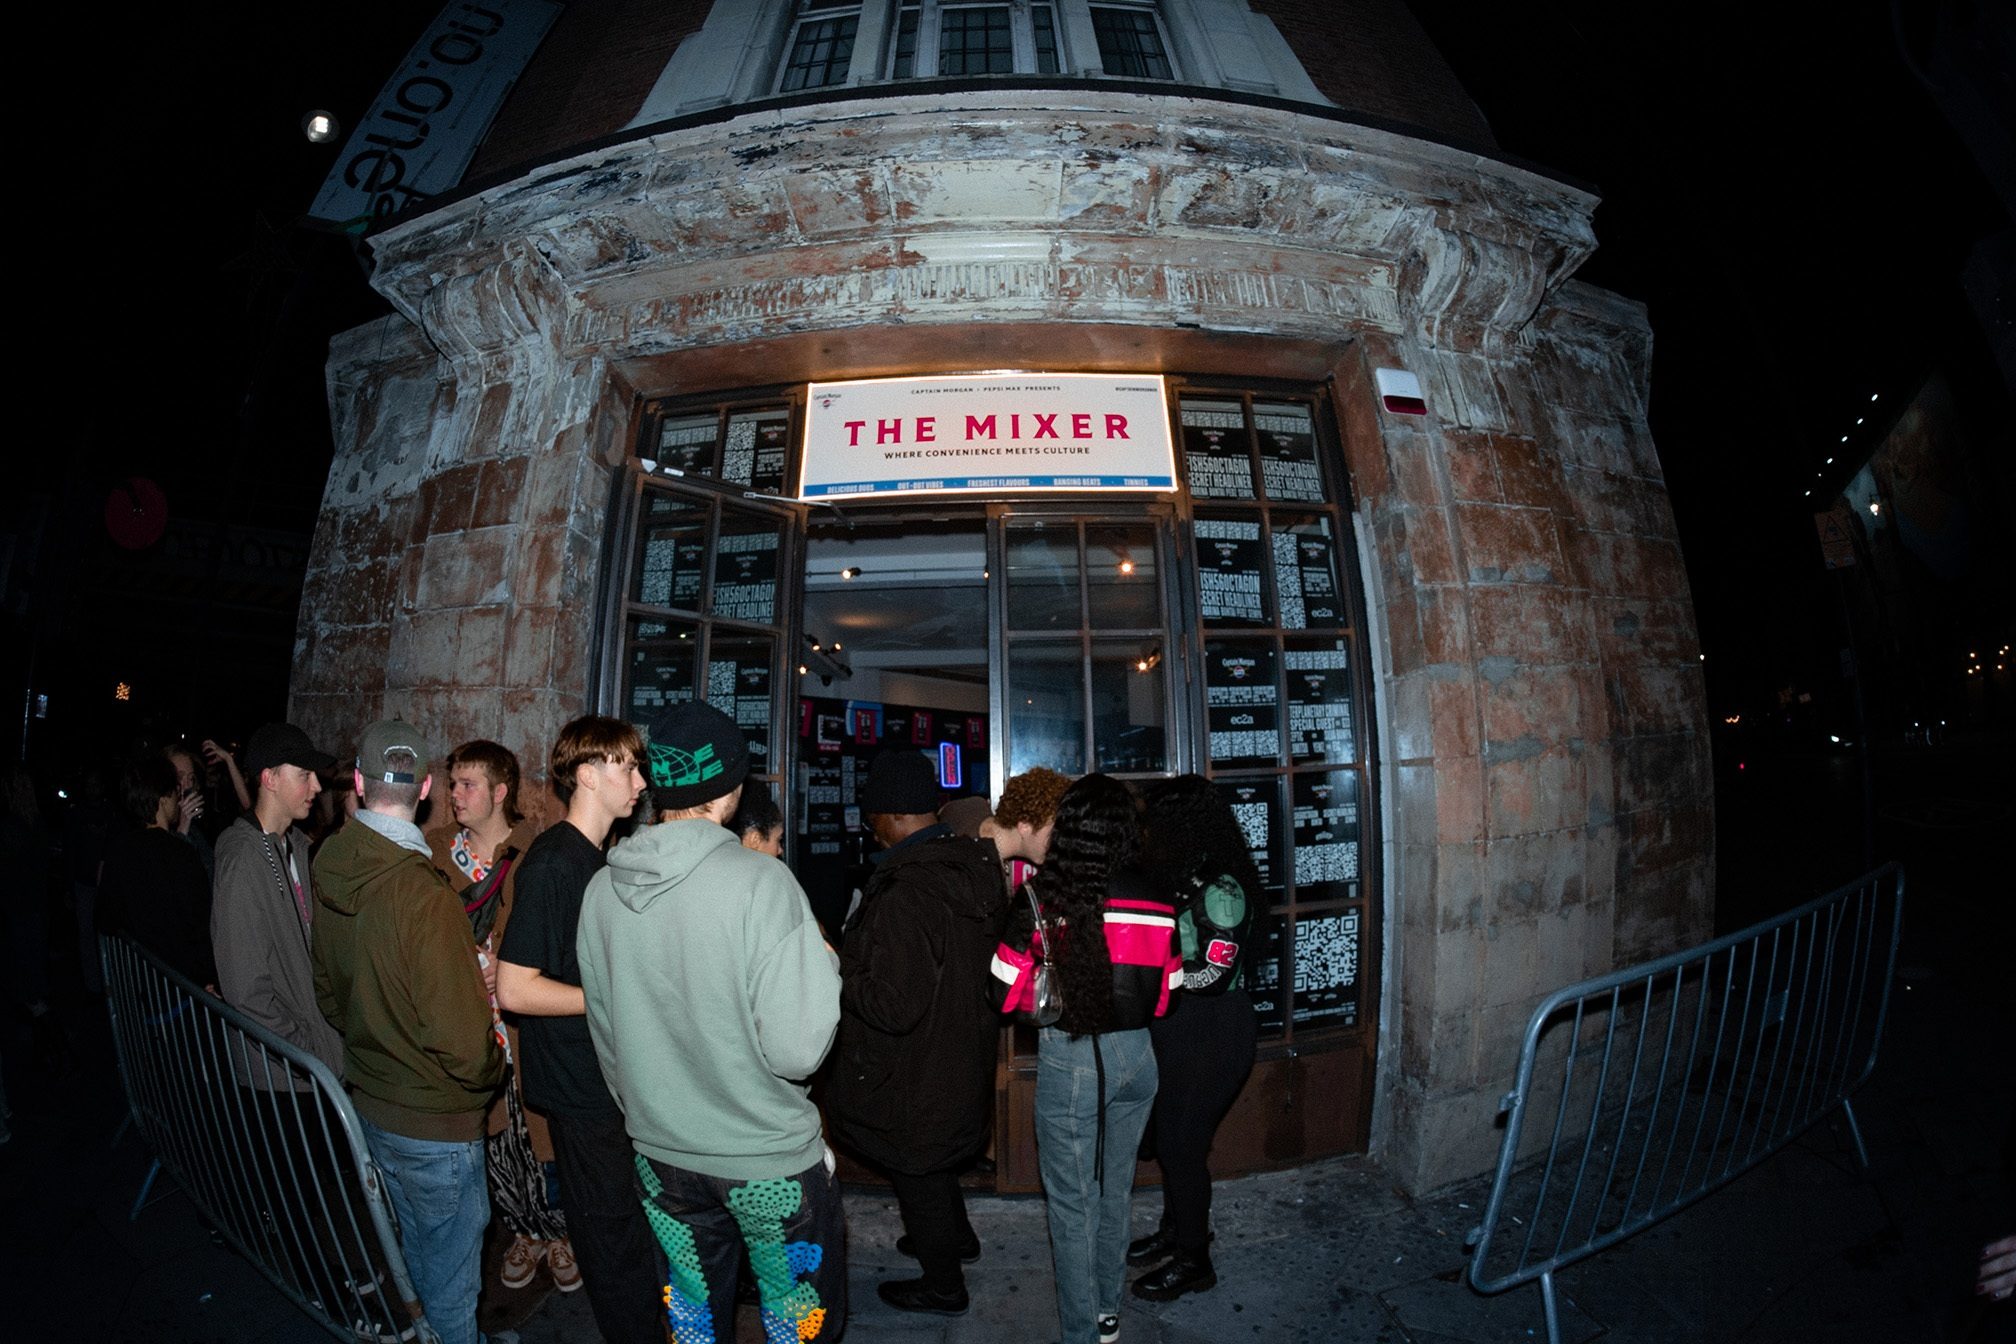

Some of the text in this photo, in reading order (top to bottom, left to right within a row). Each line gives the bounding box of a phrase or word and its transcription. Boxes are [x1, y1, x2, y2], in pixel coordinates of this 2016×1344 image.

[843, 413, 1131, 447] THE MIXER
[884, 446, 1090, 460] WHERE CONVENIENCE MEETS CULTURE
[1261, 459, 1319, 480] ISH56OCTAGON
[1263, 474, 1286, 490] ECRET
[1200, 571, 1261, 593] ISH56OCTAGON
[1201, 589, 1225, 606] ECRET
